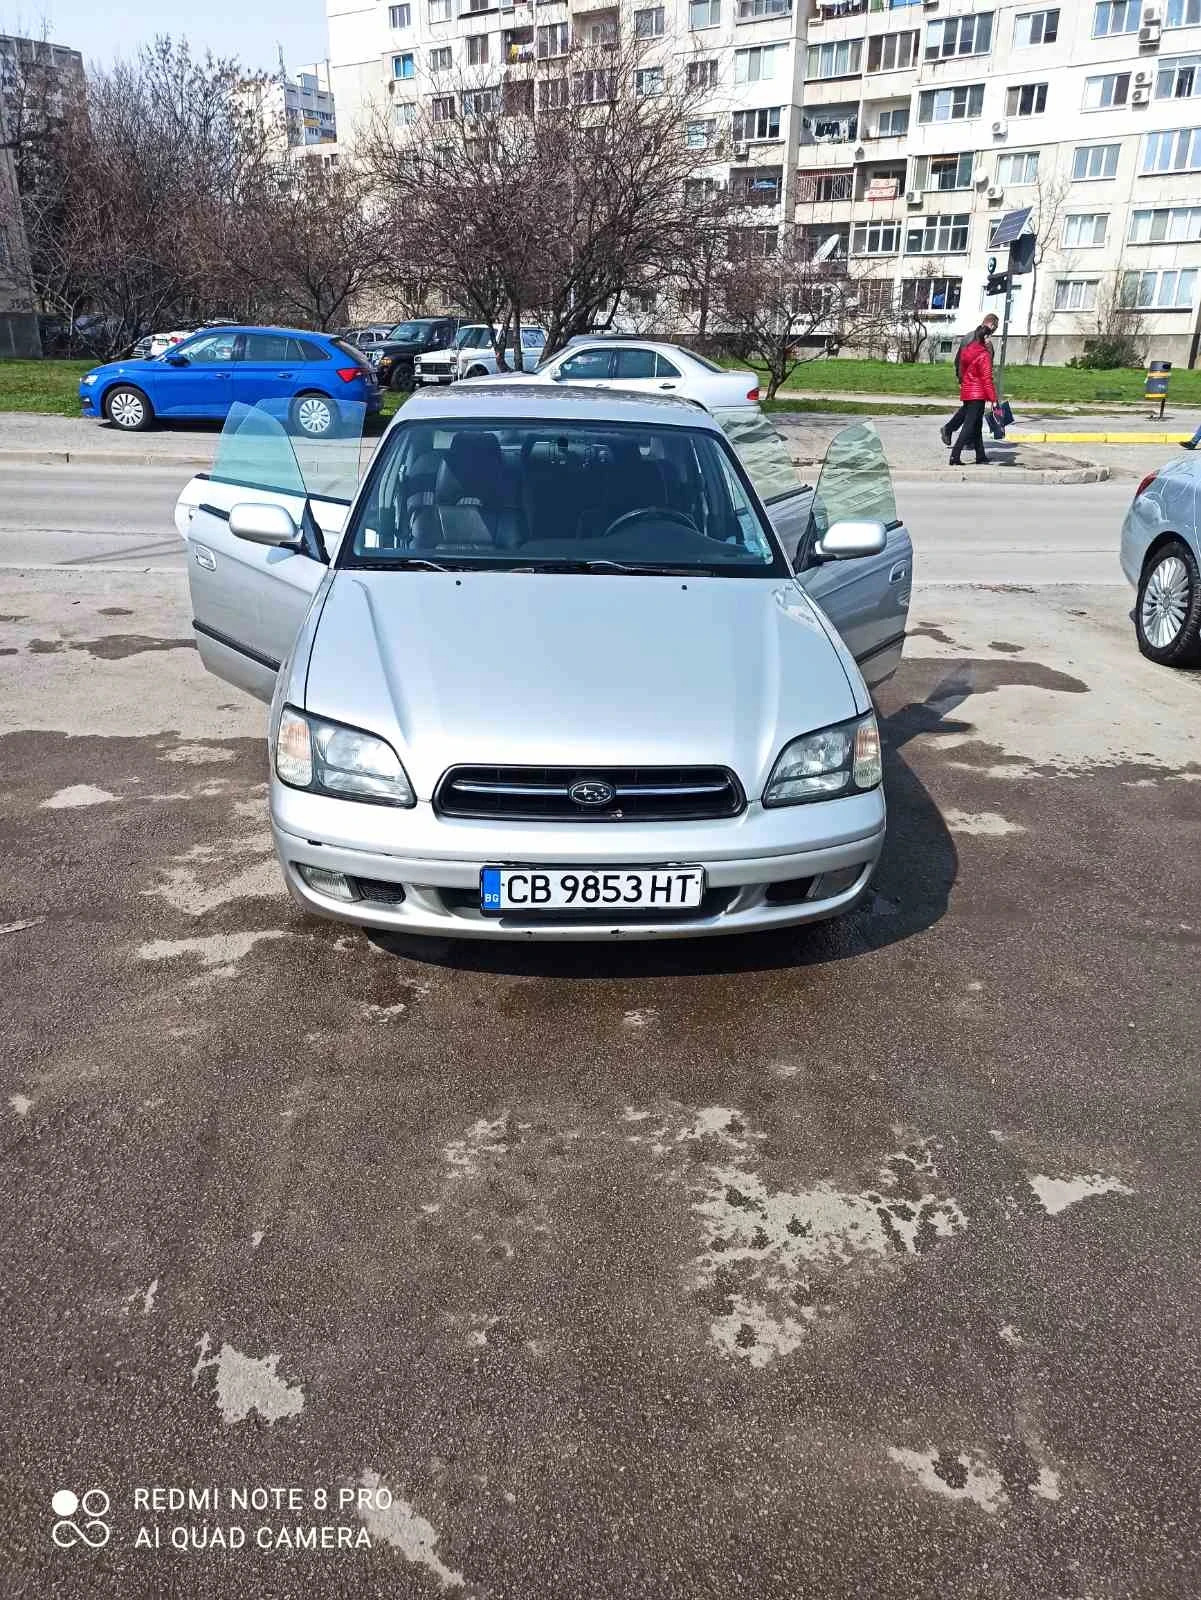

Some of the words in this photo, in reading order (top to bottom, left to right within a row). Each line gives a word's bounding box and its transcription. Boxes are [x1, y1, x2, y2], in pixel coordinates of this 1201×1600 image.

[507, 875, 551, 903] CB
[560, 875, 642, 903] 9853
[650, 874, 696, 903] HT
[484, 894, 499, 902] BG
